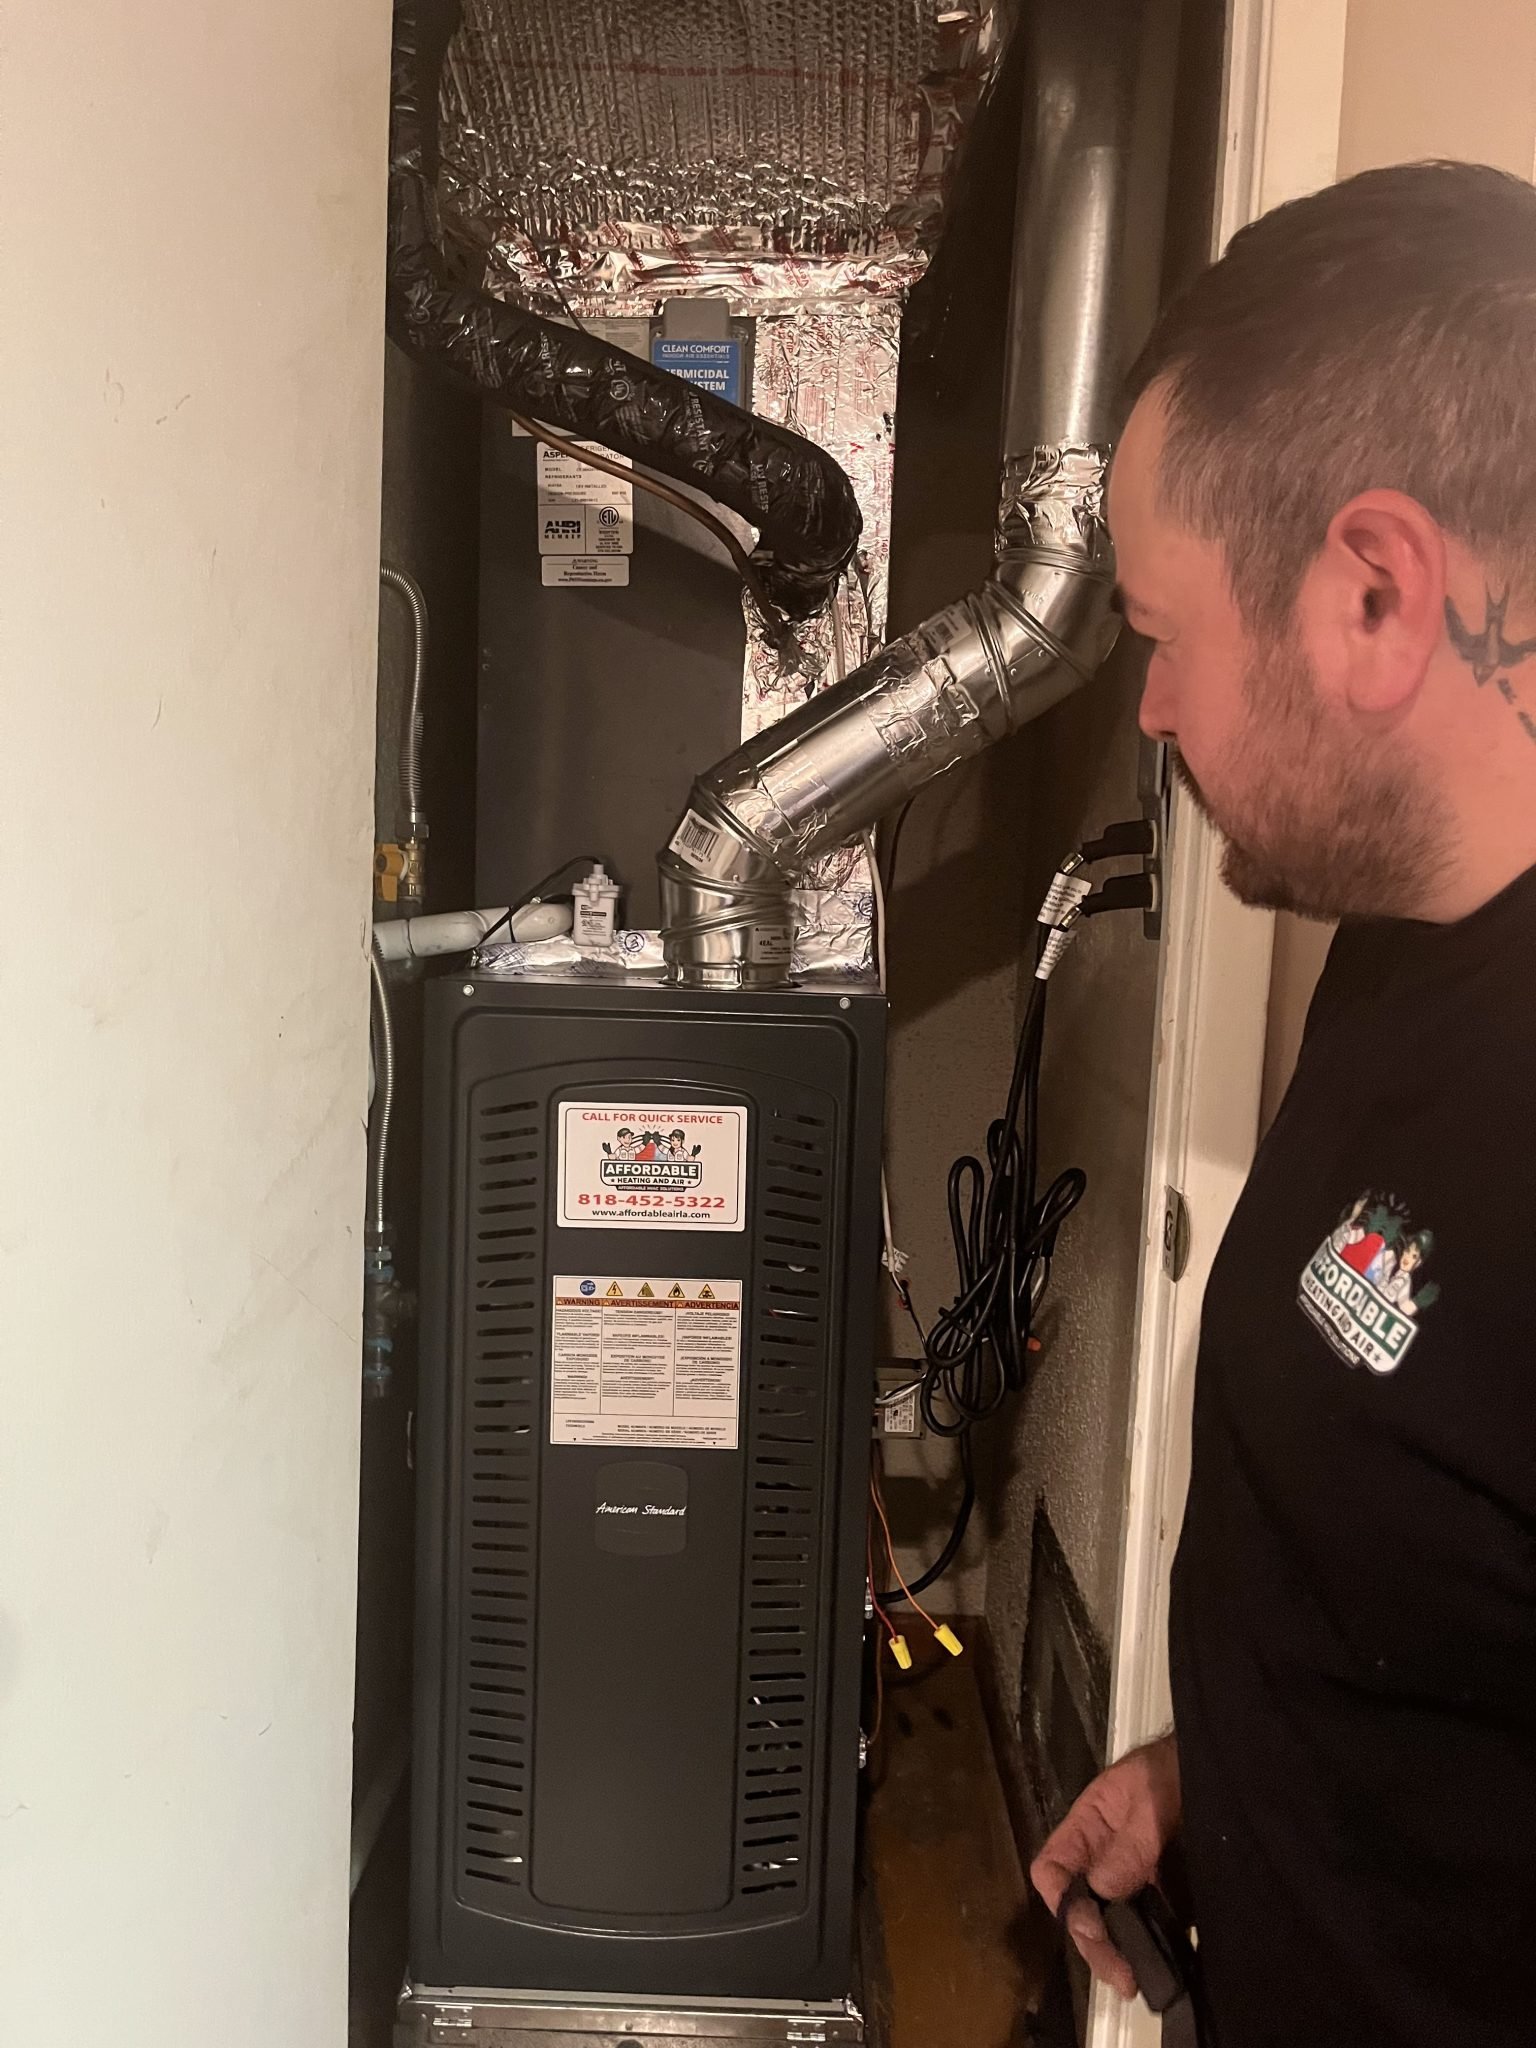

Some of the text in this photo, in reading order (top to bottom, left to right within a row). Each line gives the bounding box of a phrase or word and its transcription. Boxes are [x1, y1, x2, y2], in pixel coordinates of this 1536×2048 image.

[662, 344, 730, 354] CLEAN COMFORT
[582, 1112, 724, 1124] CALL FOR QUICK SERVICE
[605, 1164, 697, 1177] AFFORDABLE
[578, 1193, 726, 1209] 818-452-5322
[592, 1209, 711, 1220] www.affordableairla.com
[564, 1298, 740, 1310] WARNING AVERTISSEMENT ADVERTENCIA
[1350, 1332, 1374, 1360] AIR
[596, 1502, 687, 1516] American Standard
